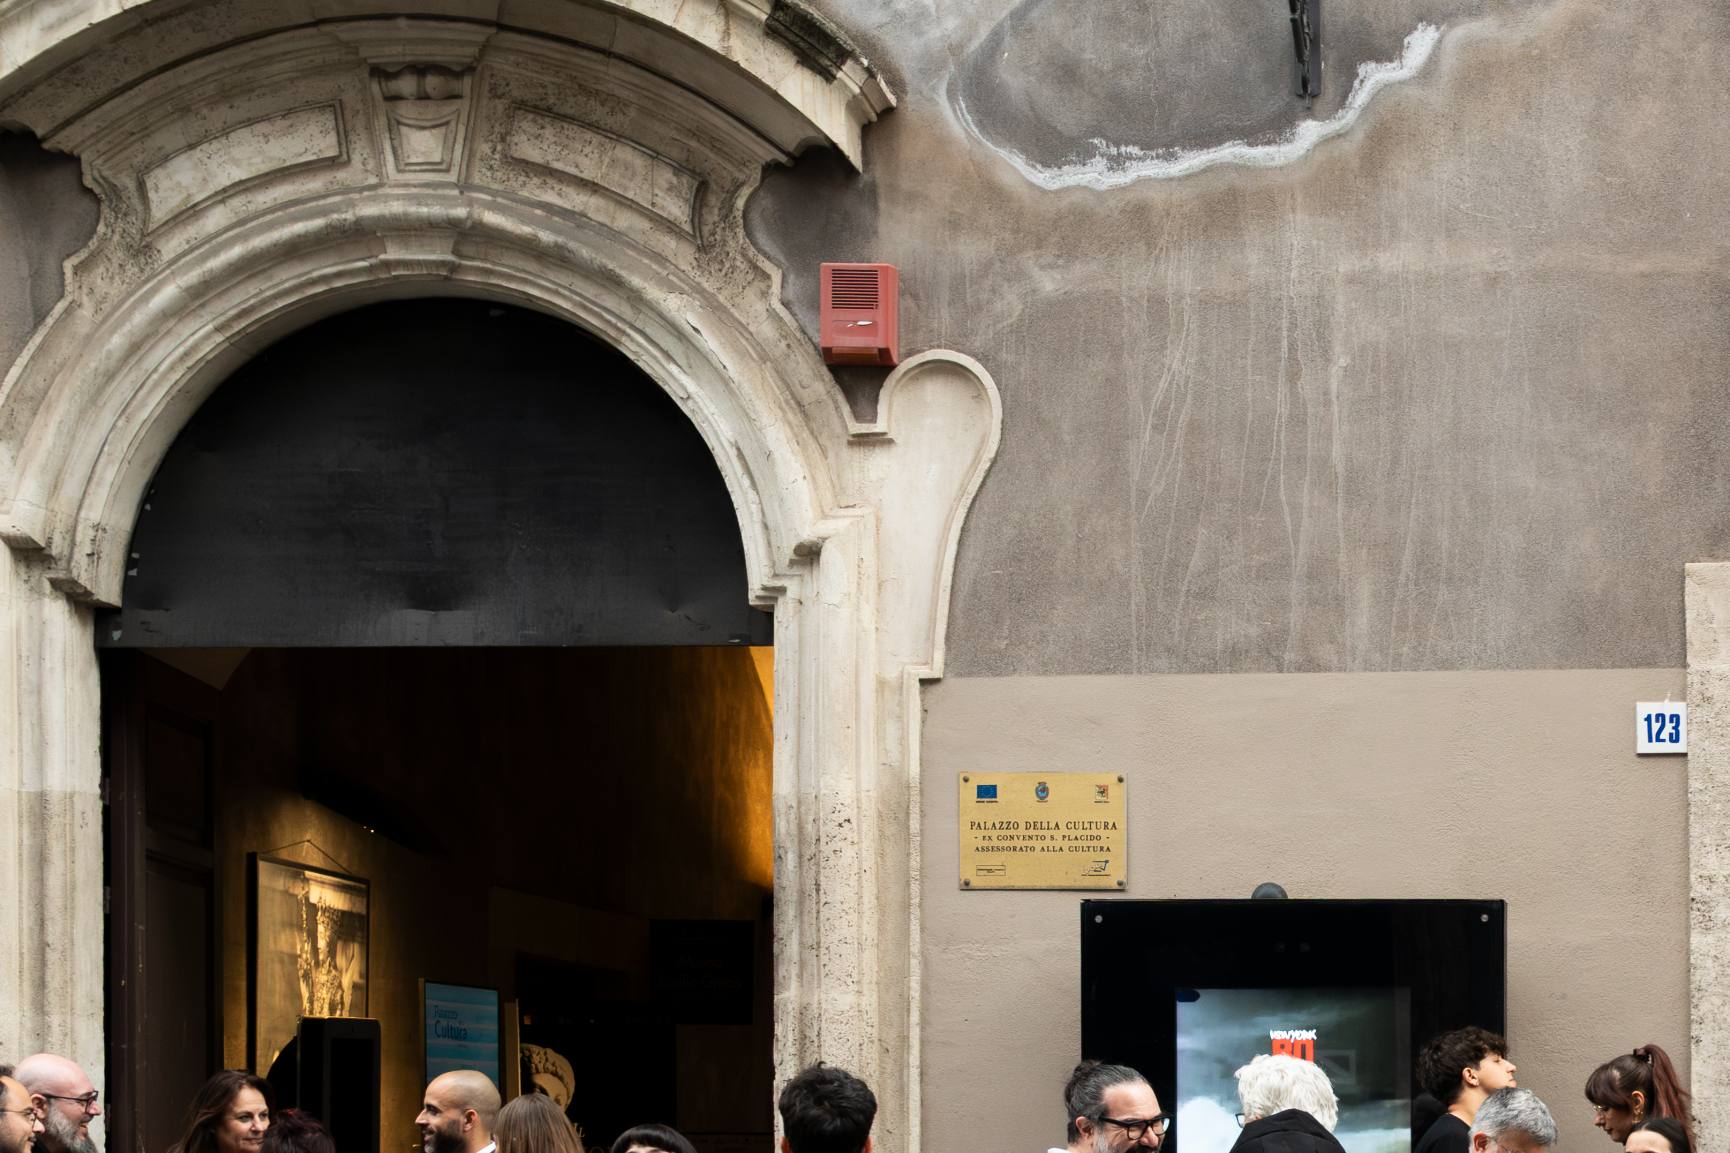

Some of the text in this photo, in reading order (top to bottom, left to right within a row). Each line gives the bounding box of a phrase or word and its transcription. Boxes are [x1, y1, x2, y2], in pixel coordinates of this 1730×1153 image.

[1643, 712, 1681, 744] 123
[970, 821, 1118, 831] PALAZZO DELLA CULTURA
[996, 834, 1047, 842] CONVENTO
[1049, 834, 1058, 842] S.
[1061, 834, 1102, 842] PLACIDO
[974, 845, 1112, 853] ASSESSORATO ALLA CULTURA
[677, 953, 722, 969] Museo
